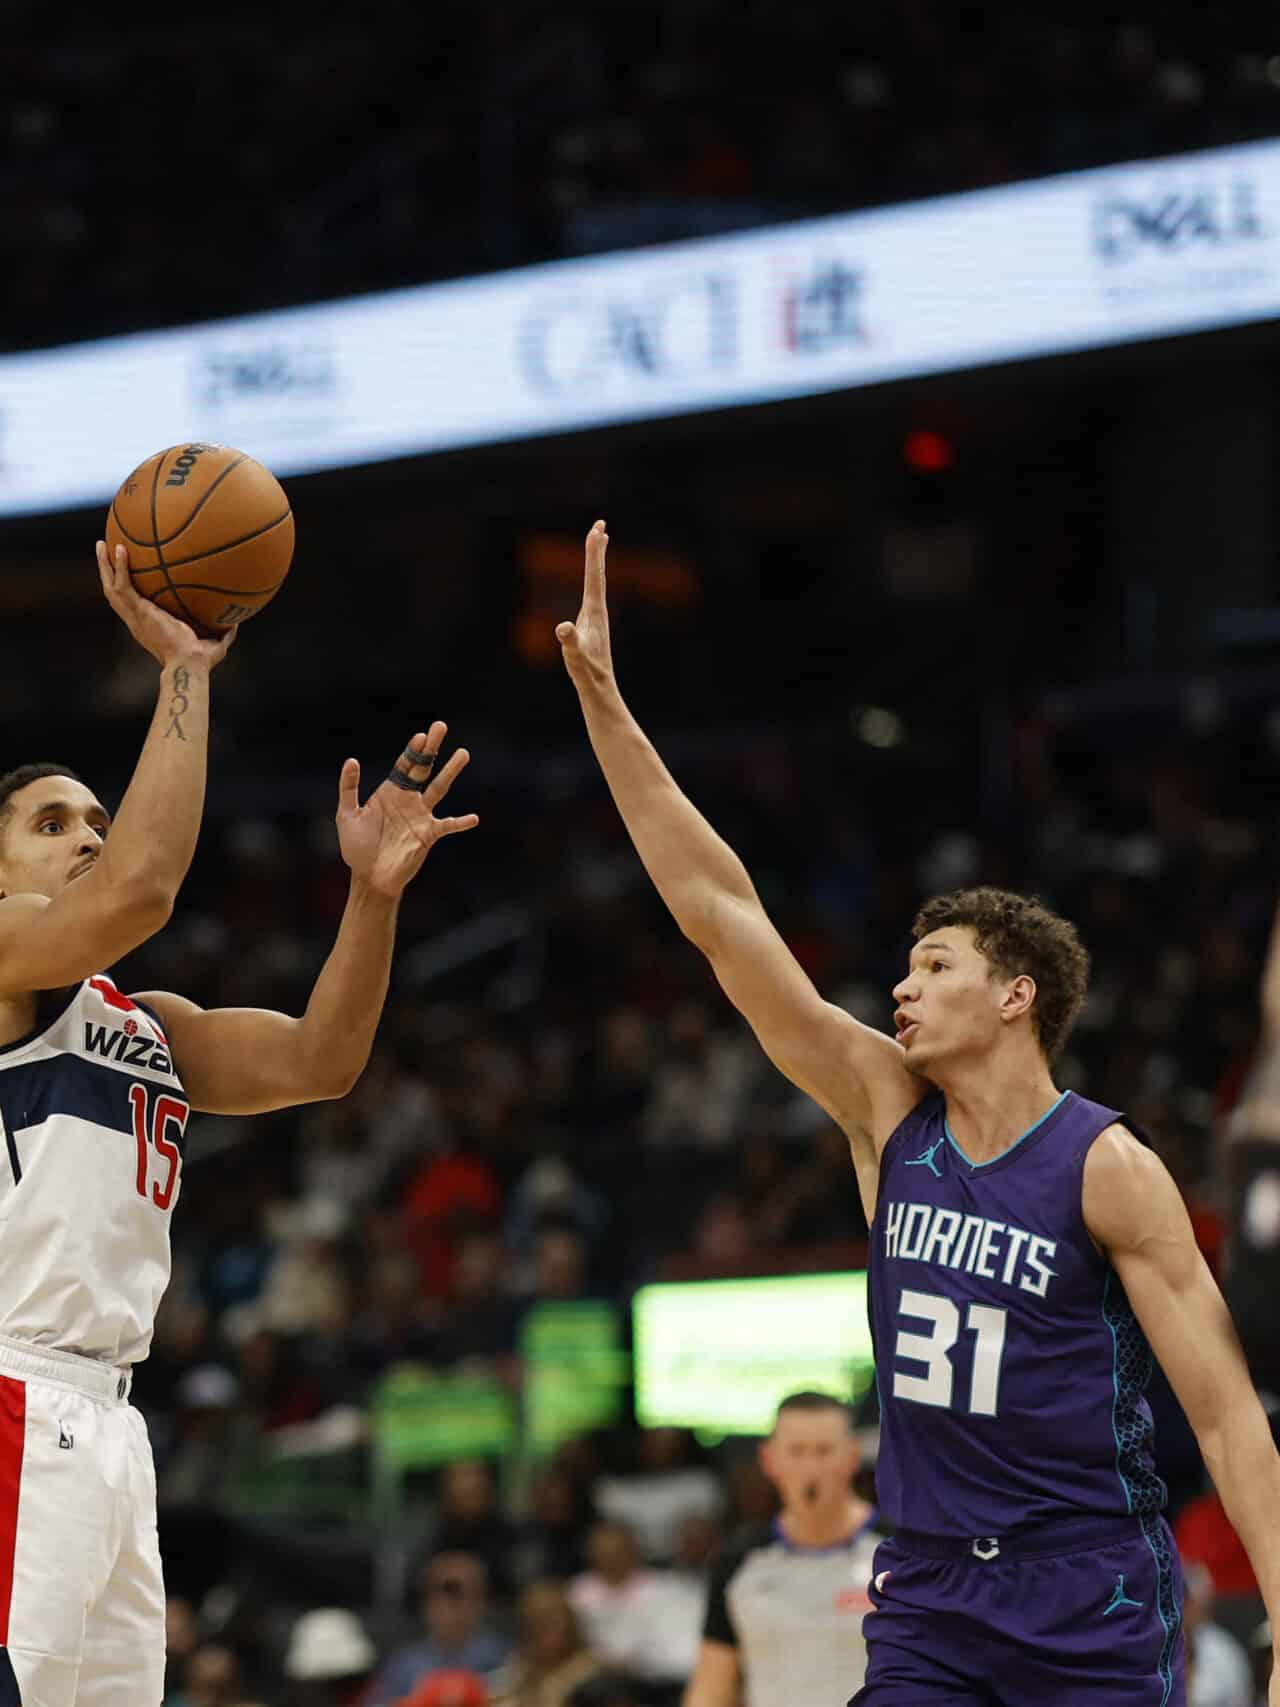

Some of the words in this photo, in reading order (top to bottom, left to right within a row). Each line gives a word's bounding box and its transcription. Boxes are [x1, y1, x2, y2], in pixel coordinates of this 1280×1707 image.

[128, 1082, 190, 1211] 15
[885, 1202, 1059, 1298] HORNETS
[893, 1289, 1008, 1417] 31
